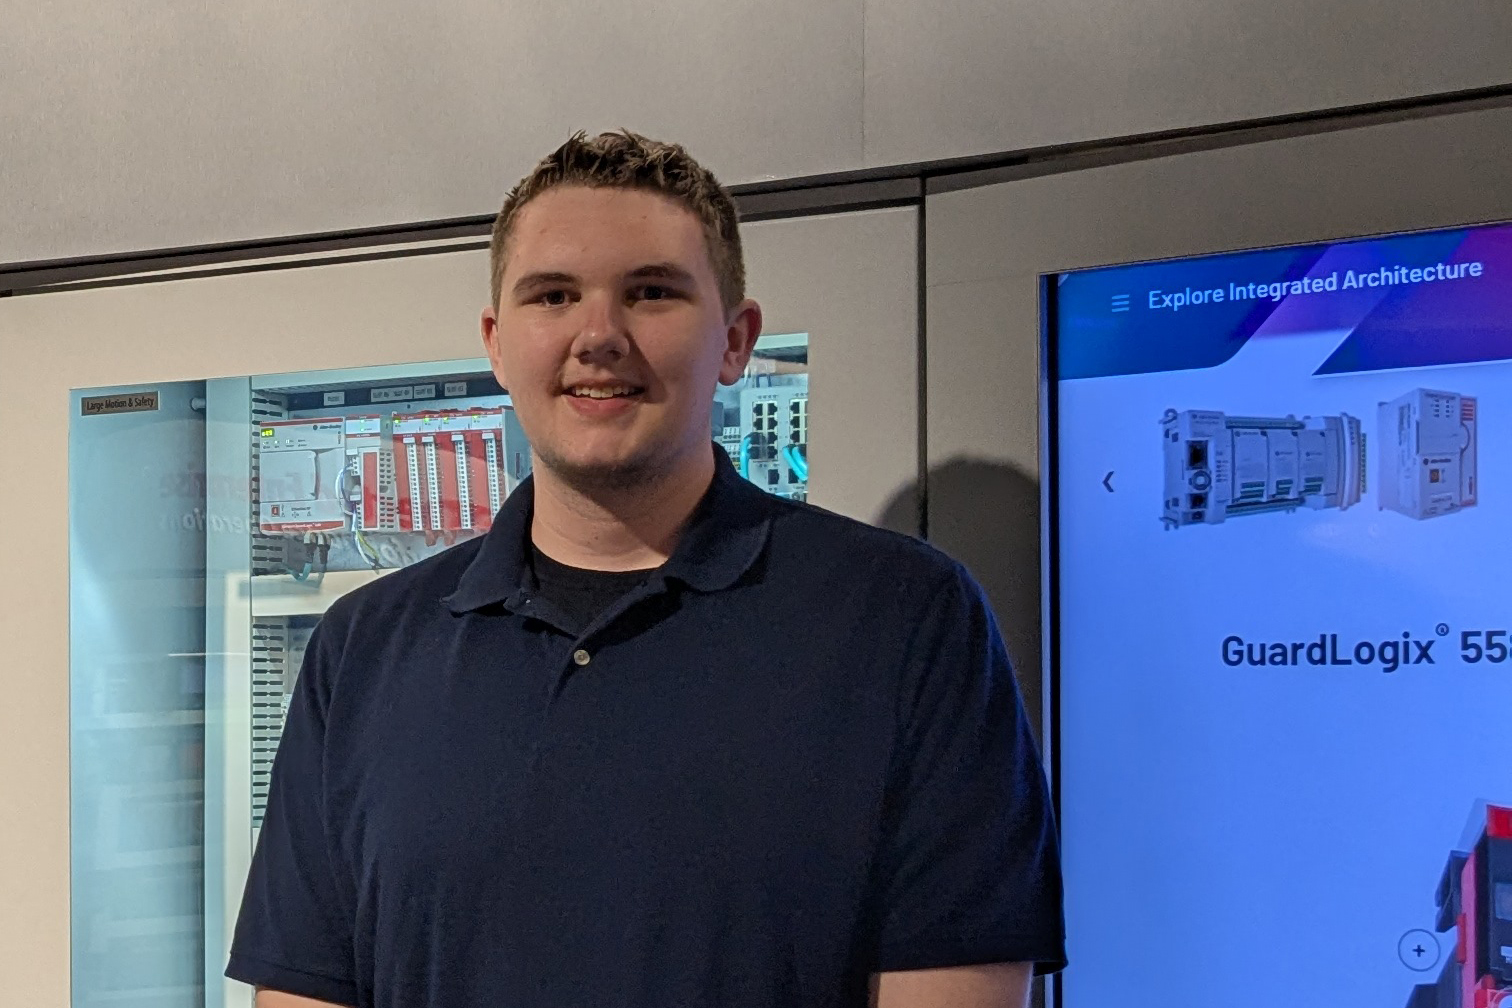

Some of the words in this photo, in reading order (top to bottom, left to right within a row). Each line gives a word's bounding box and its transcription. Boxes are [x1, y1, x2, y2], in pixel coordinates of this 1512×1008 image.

[1148, 287, 1225, 312] Explore
[1229, 271, 1337, 302] Integrated
[1341, 261, 1483, 290] Architecture
[86, 400, 104, 412] Large
[105, 398, 127, 409] Motion
[127, 397, 134, 408] &
[134, 396, 155, 408] Safety
[1460, 630, 1512, 664] 55
